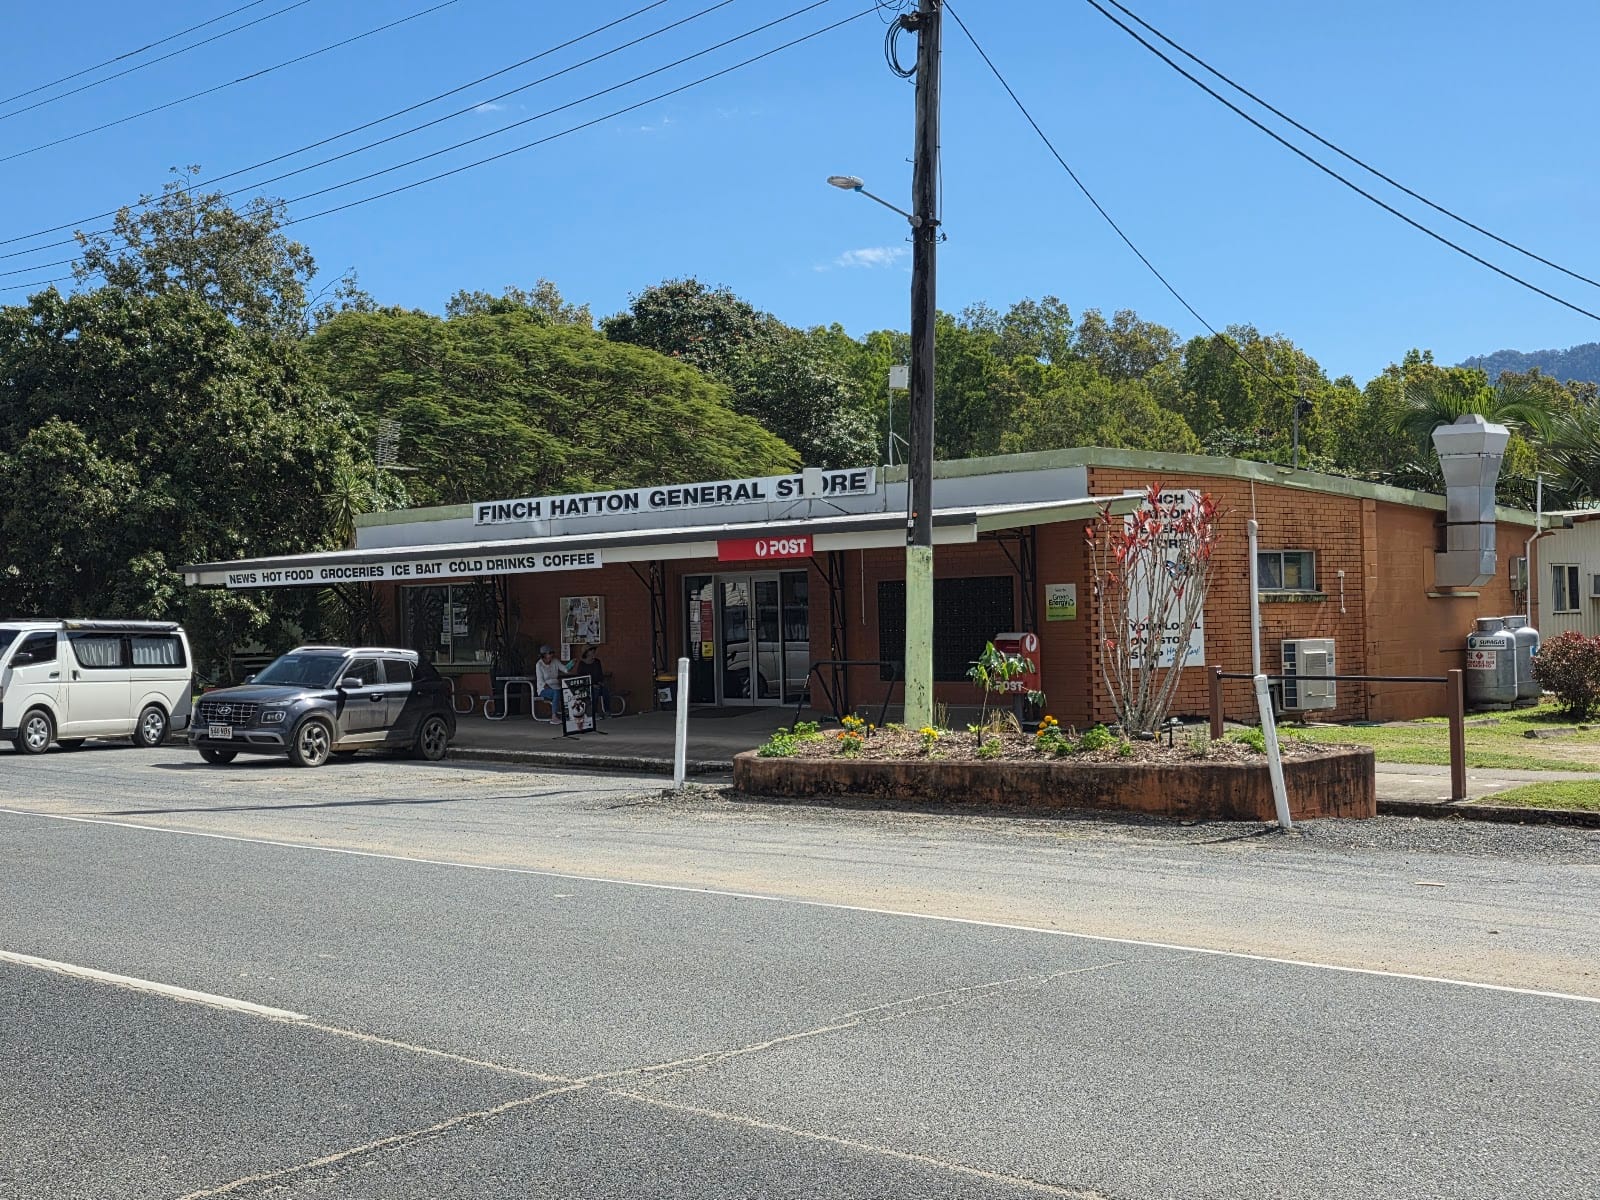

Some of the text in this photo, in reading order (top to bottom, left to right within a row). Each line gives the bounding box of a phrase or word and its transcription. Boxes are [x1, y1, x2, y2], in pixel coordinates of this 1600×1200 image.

[479, 501, 542, 522] FINCH
[551, 492, 640, 516] HATTON
[650, 482, 767, 508] GENERAL
[769, 538, 807, 555] POST
[229, 552, 595, 585] NEWS HOT FOOD GROCERIES ICE BAIT COLD DRINKS COFFEE
